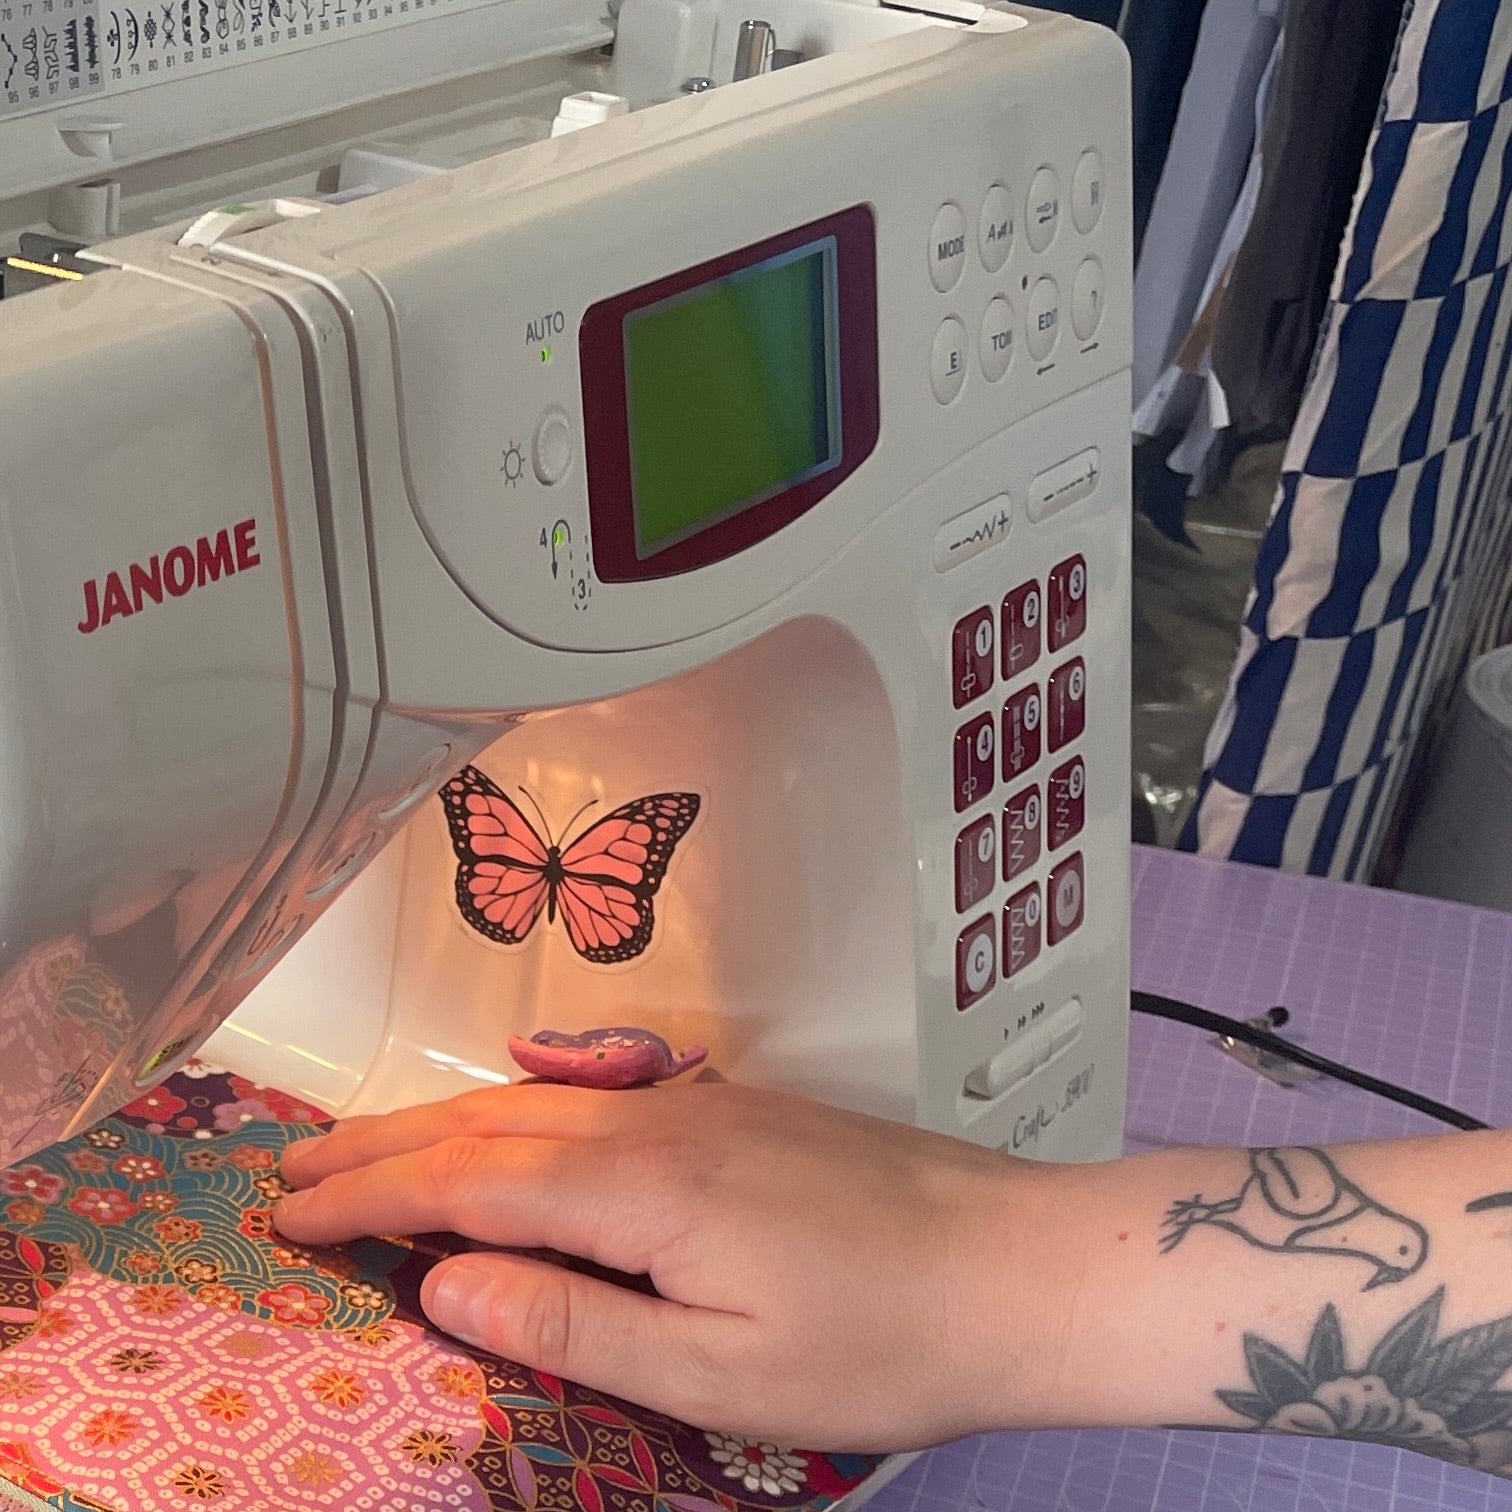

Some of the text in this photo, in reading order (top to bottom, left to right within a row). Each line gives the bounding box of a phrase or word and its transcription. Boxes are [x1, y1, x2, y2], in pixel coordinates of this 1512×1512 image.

[1, 8, 12, 21] 76
[22, 3, 33, 16] 77
[8, 90, 19, 103] 95
[938, 235, 965, 261] MODE
[525, 311, 565, 345] AUTO
[950, 351, 958, 370] E
[540, 527, 548, 548] 4
[77, 518, 261, 634] JANOME
[1073, 570, 1081, 593] 3
[577, 579, 586, 600] 3
[1027, 598, 1036, 621] 2
[979, 626, 987, 650] 1
[1073, 671, 1080, 690] 6
[1028, 701, 1036, 724] 5
[981, 730, 989, 752] 4
[1073, 771, 1080, 793] 9
[1029, 801, 1036, 823] 8
[982, 832, 990, 856] 7
